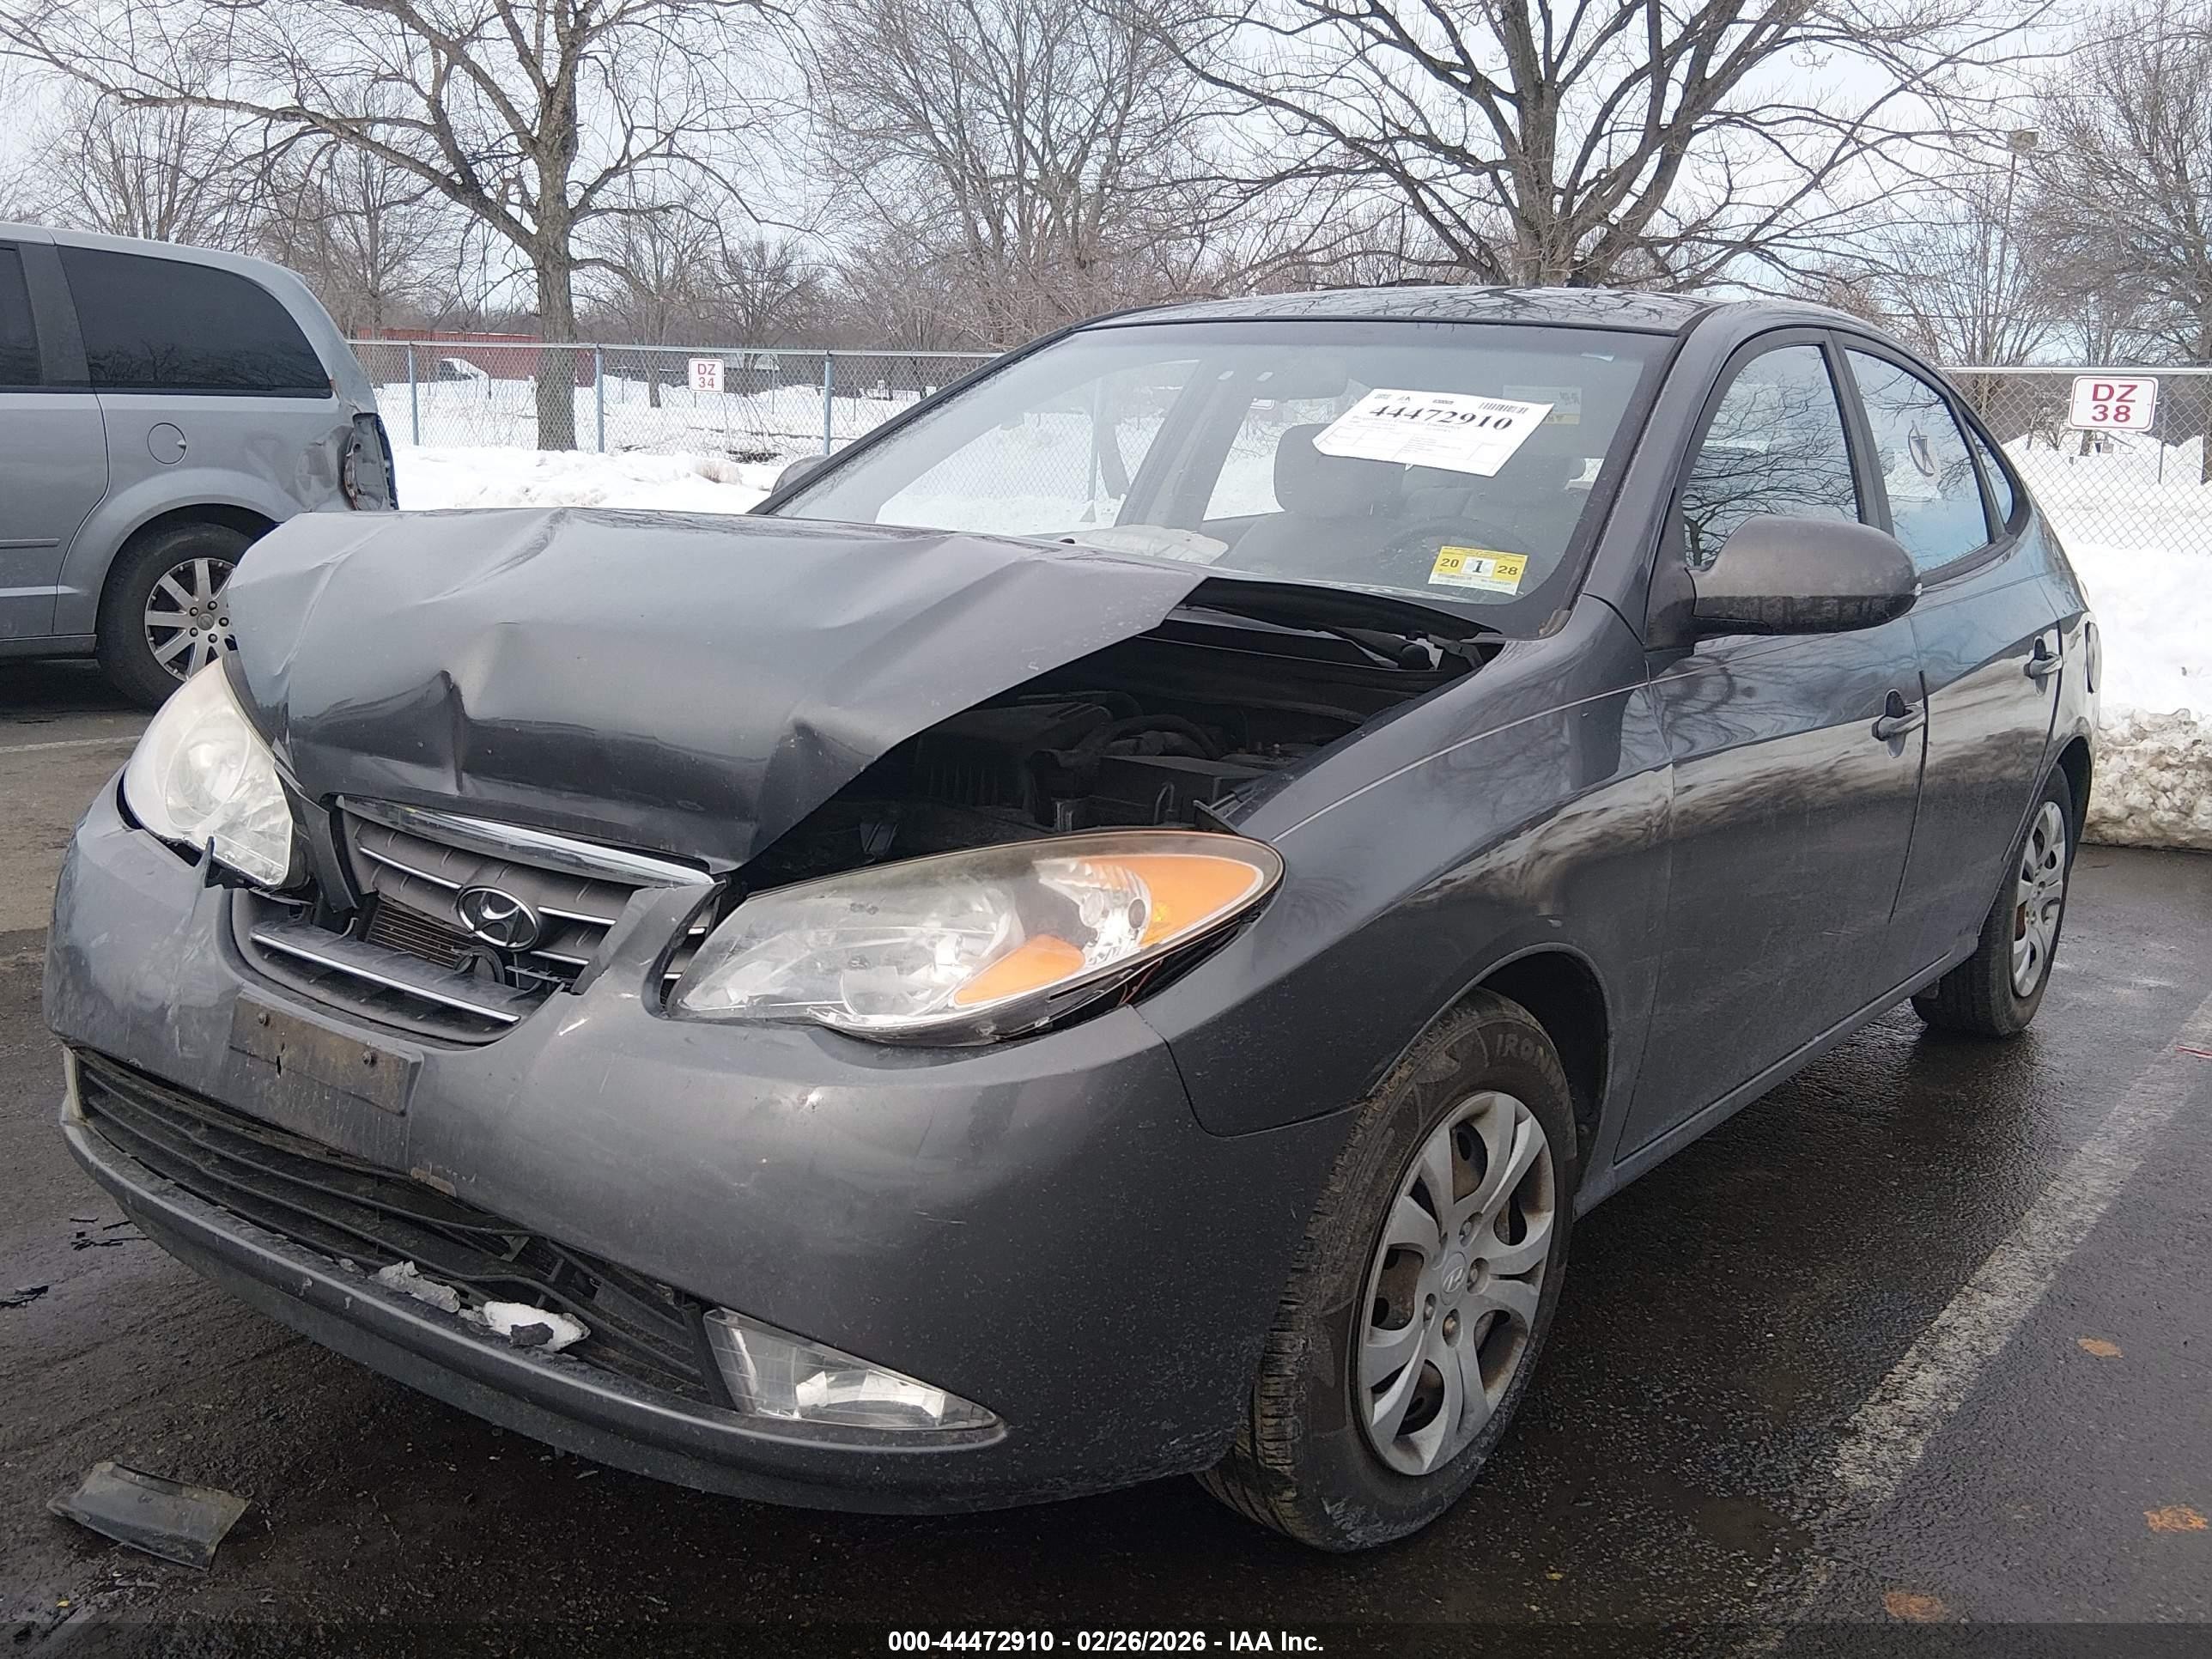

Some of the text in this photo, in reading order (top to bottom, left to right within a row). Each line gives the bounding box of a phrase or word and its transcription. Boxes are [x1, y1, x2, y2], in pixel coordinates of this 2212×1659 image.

[697, 363, 716, 376] DZ
[698, 376, 714, 388] 34
[2092, 384, 2138, 403] DZ
[1369, 404, 1513, 430] 44472910
[2091, 404, 2131, 422] 38
[1440, 558, 1519, 575] 20 1 28
